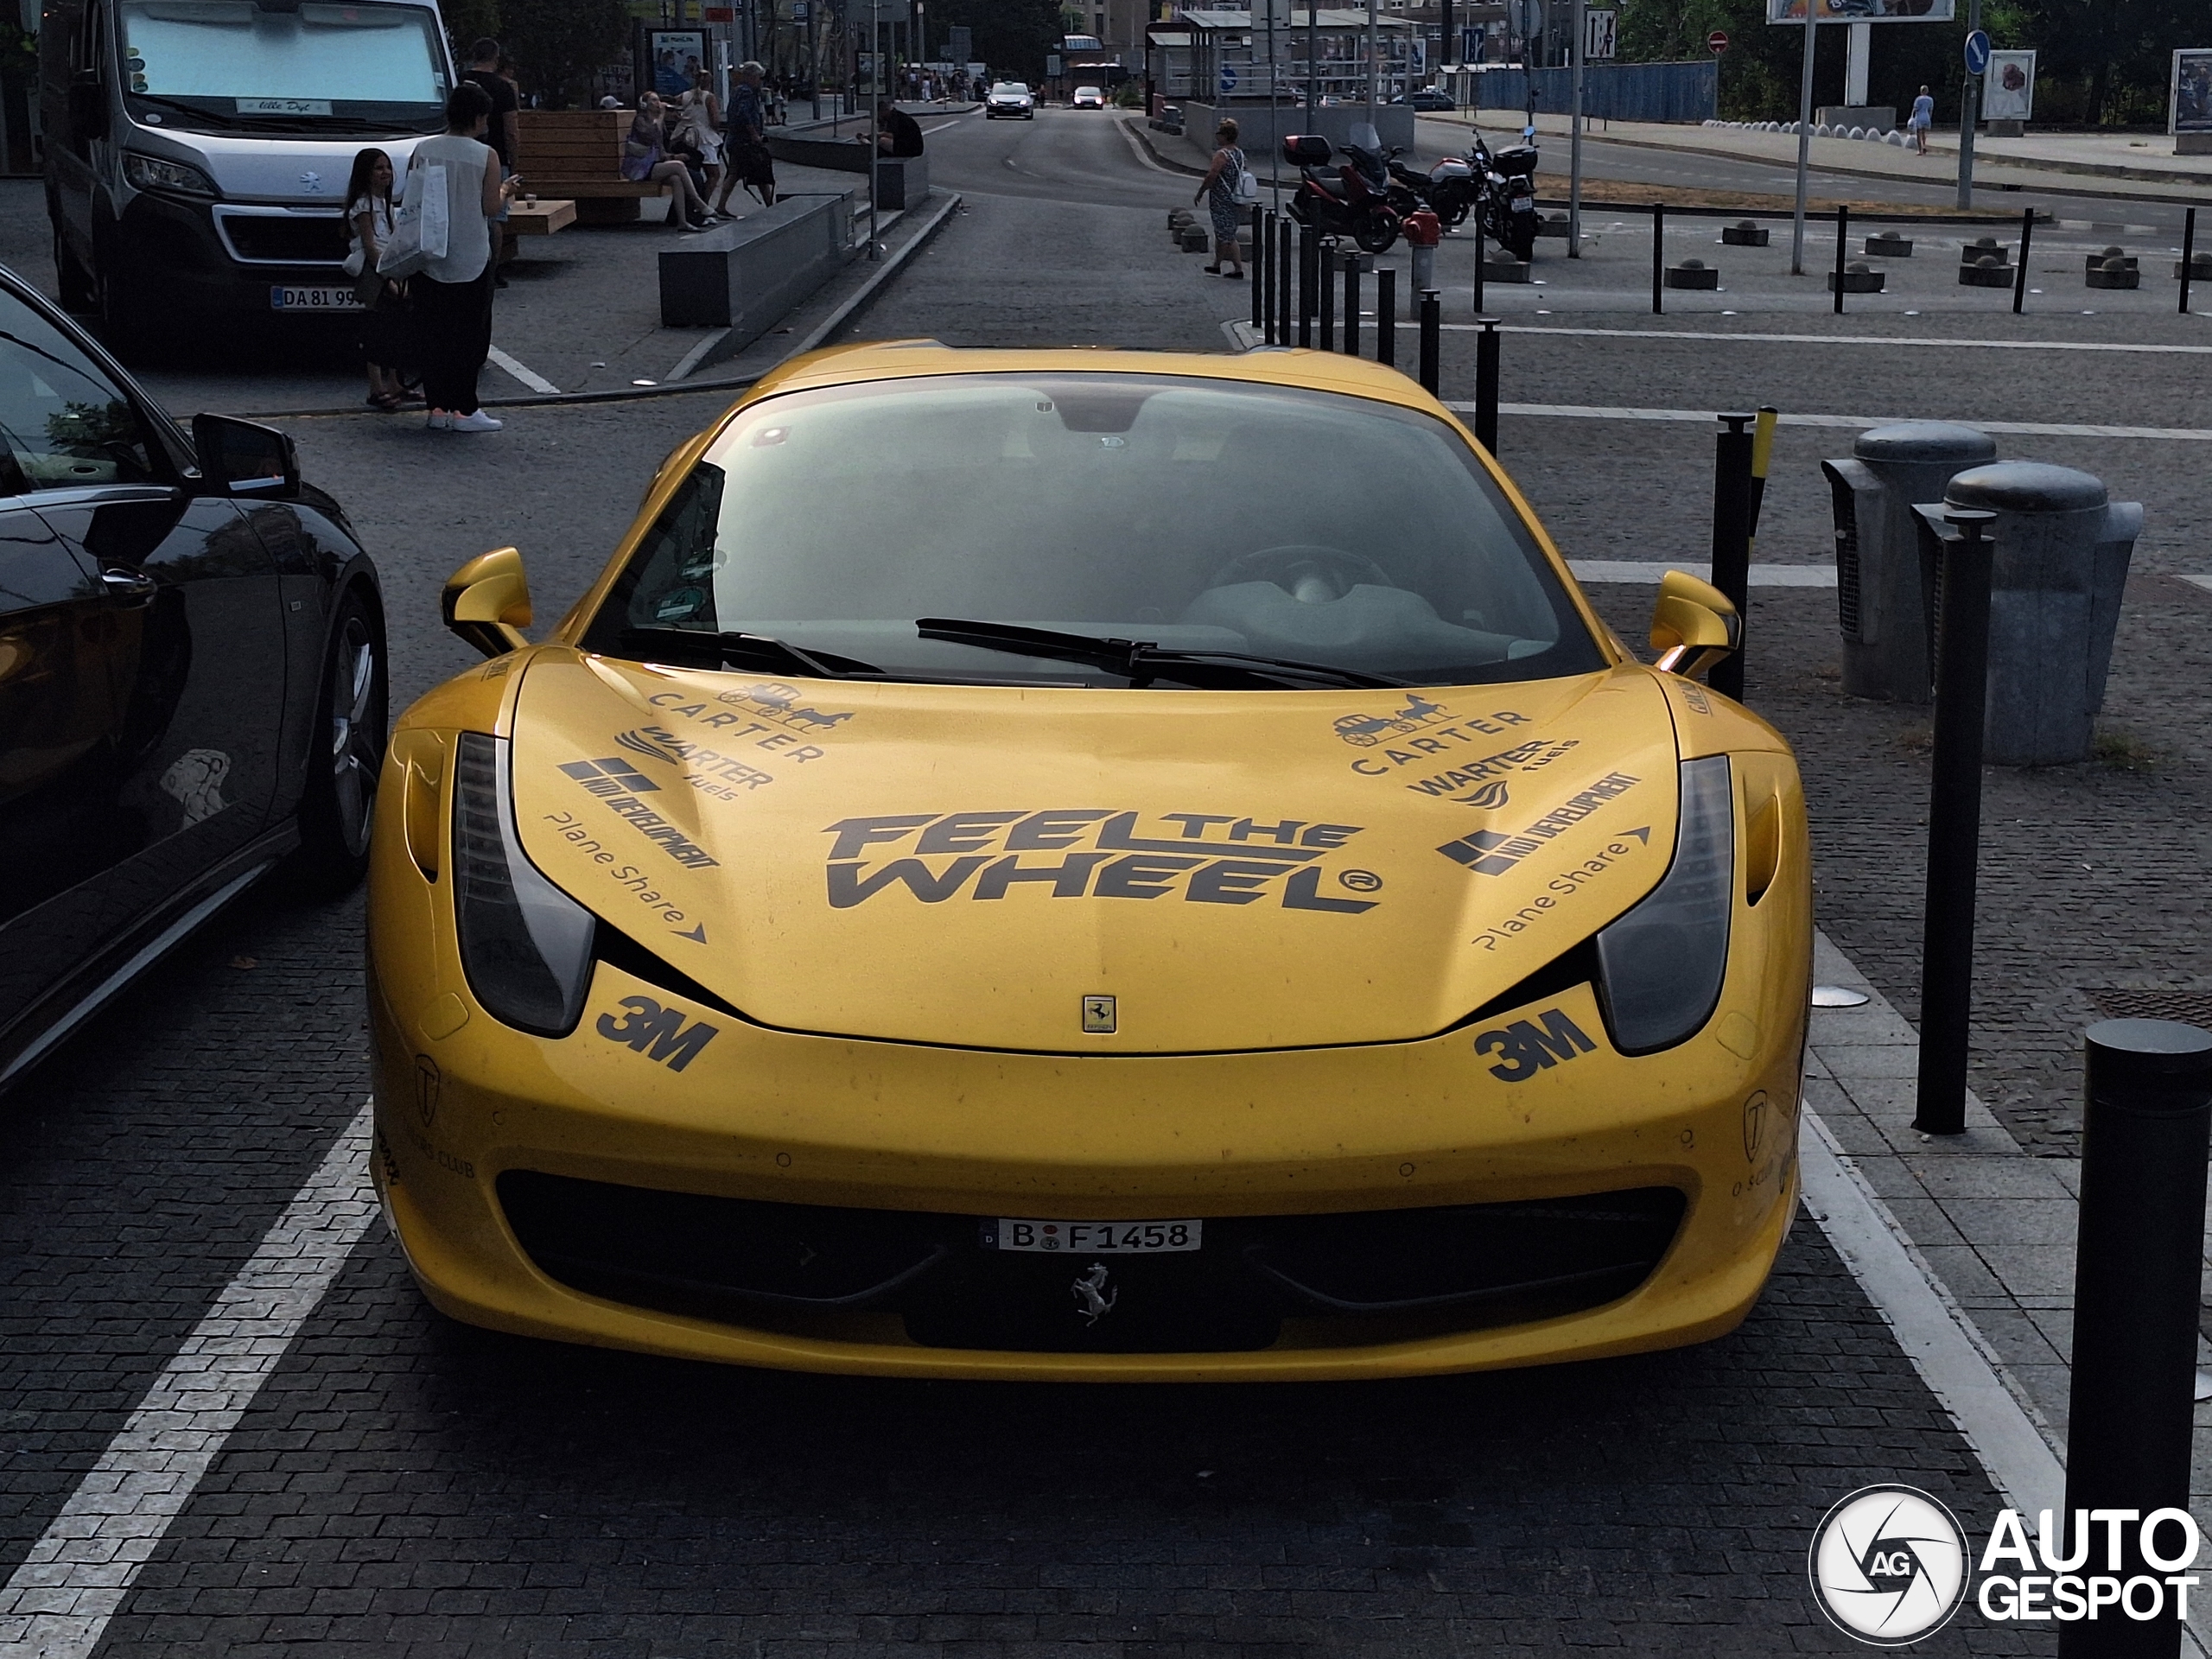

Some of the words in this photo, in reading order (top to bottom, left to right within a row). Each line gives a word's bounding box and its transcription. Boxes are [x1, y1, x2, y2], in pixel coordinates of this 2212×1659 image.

[283, 290, 308, 306] DA
[311, 290, 330, 306] 81
[335, 290, 363, 306] 99
[640, 726, 774, 791] WARTER
[648, 693, 824, 764] CARTER
[1351, 712, 1533, 775] CARTER
[1522, 738, 1580, 771] fuels
[683, 773, 739, 802] fuels
[1406, 741, 1555, 797] WARTER
[605, 796, 721, 869] DEVELOPMENT
[820, 810, 1329, 862] FEEL
[1162, 813, 1365, 848] THE
[1523, 772, 1642, 840] DEVELOPMENT
[543, 811, 615, 865] Plane
[611, 866, 685, 923] Share
[1471, 896, 1557, 951] Plane
[1549, 842, 1630, 895] Share
[596, 995, 720, 1073] 3M
[1474, 1008, 1598, 1083] 3M
[438, 1151, 474, 1179] CLUB
[1013, 1224, 1035, 1247] B
